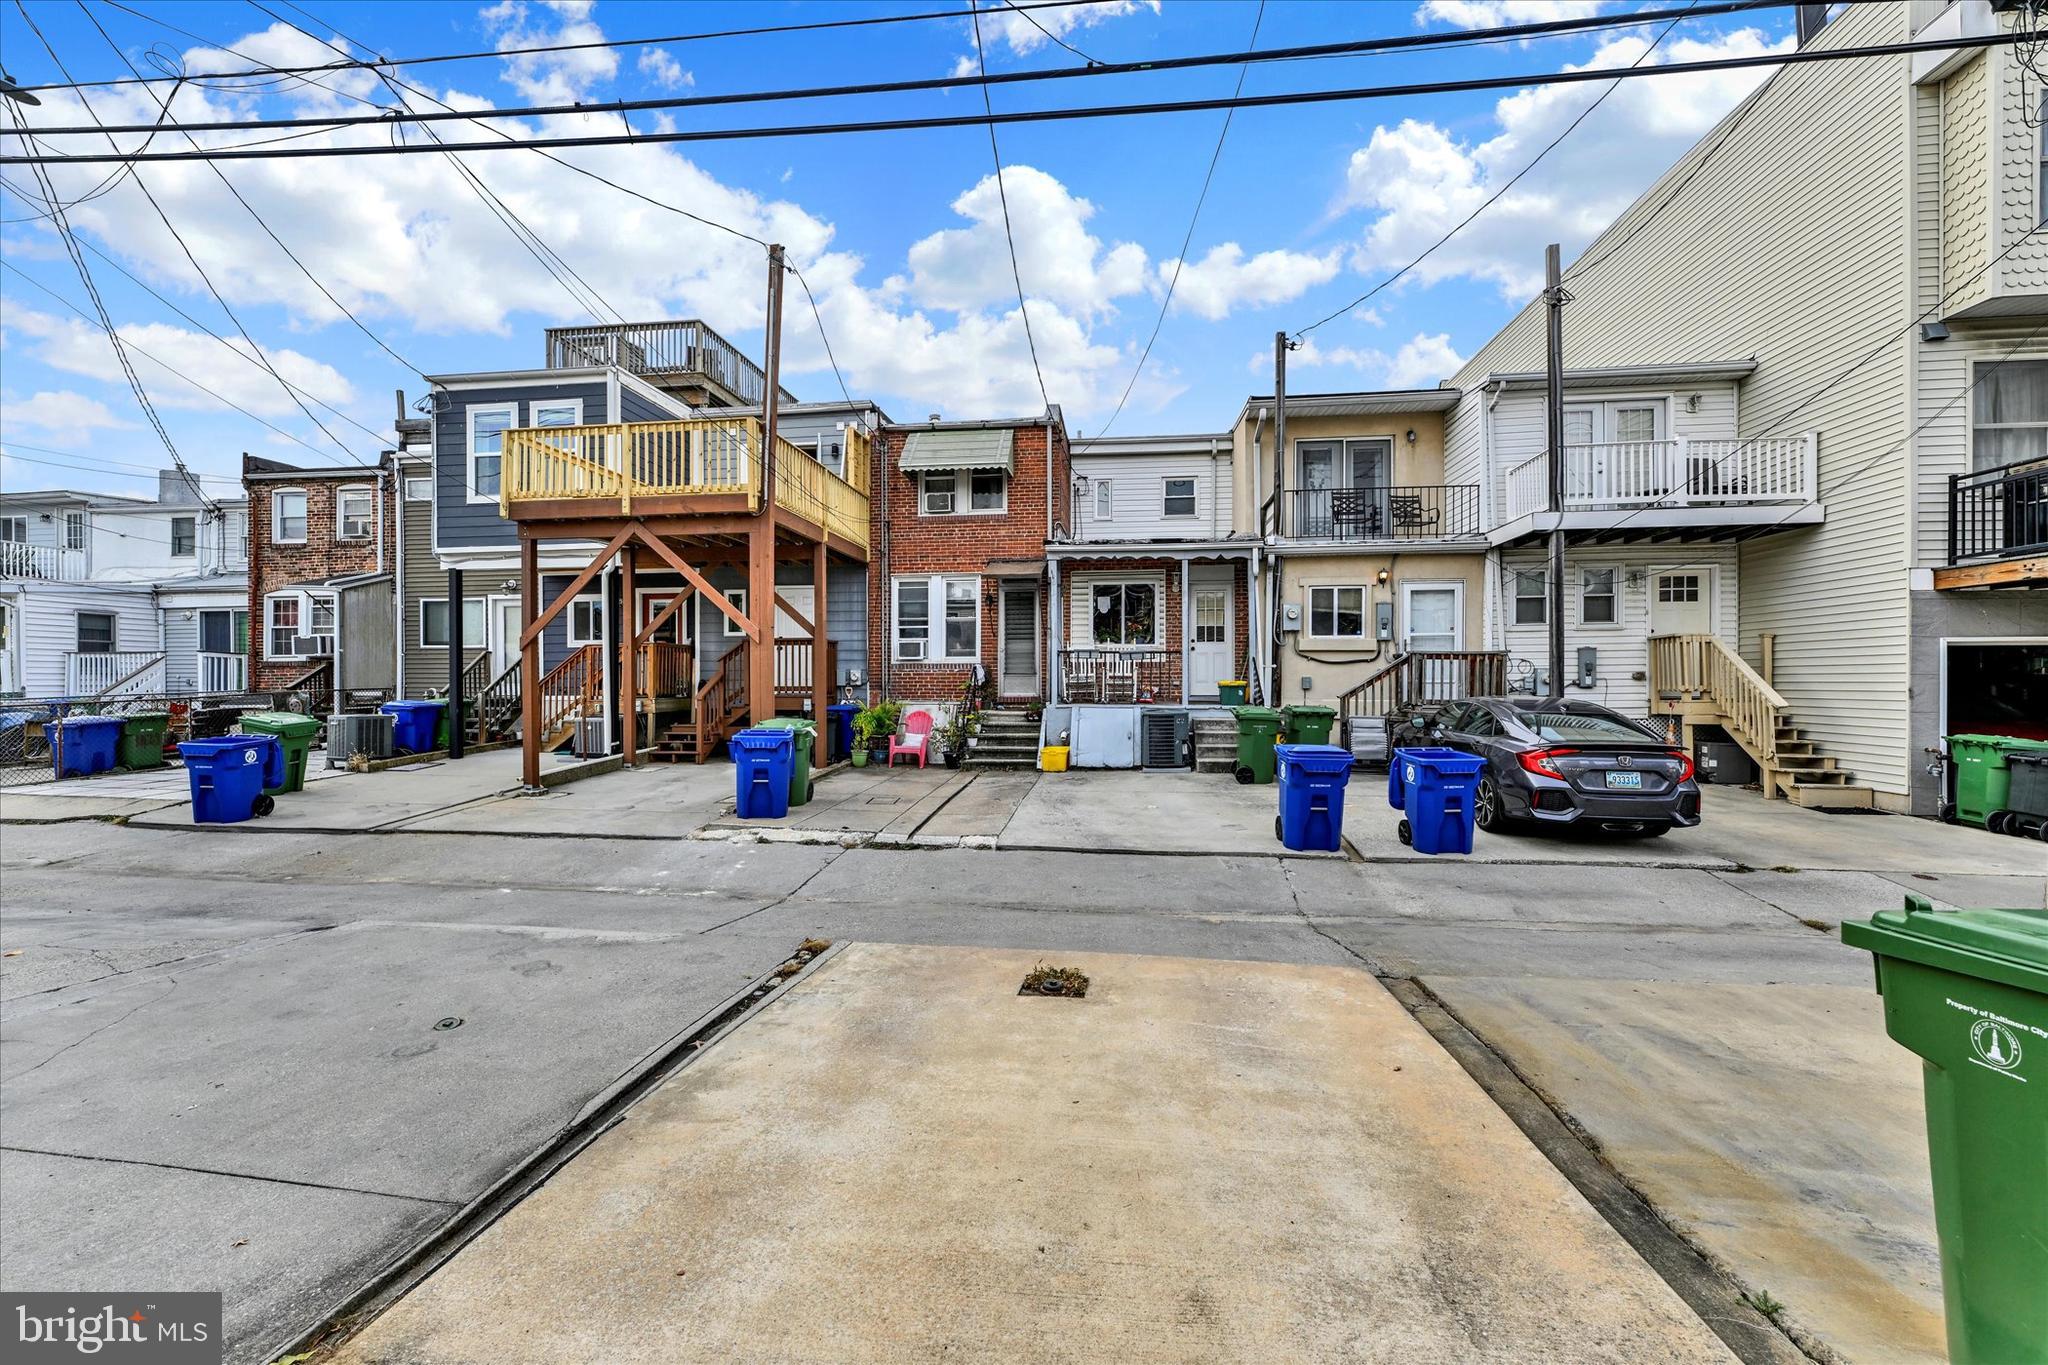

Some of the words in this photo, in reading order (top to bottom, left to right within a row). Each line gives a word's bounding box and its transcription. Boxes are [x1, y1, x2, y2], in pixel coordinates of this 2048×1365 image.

[1946, 997, 1978, 1015] Property
[1989, 1012, 2029, 1031] Baltimore
[2030, 1026, 2048, 1039] City
